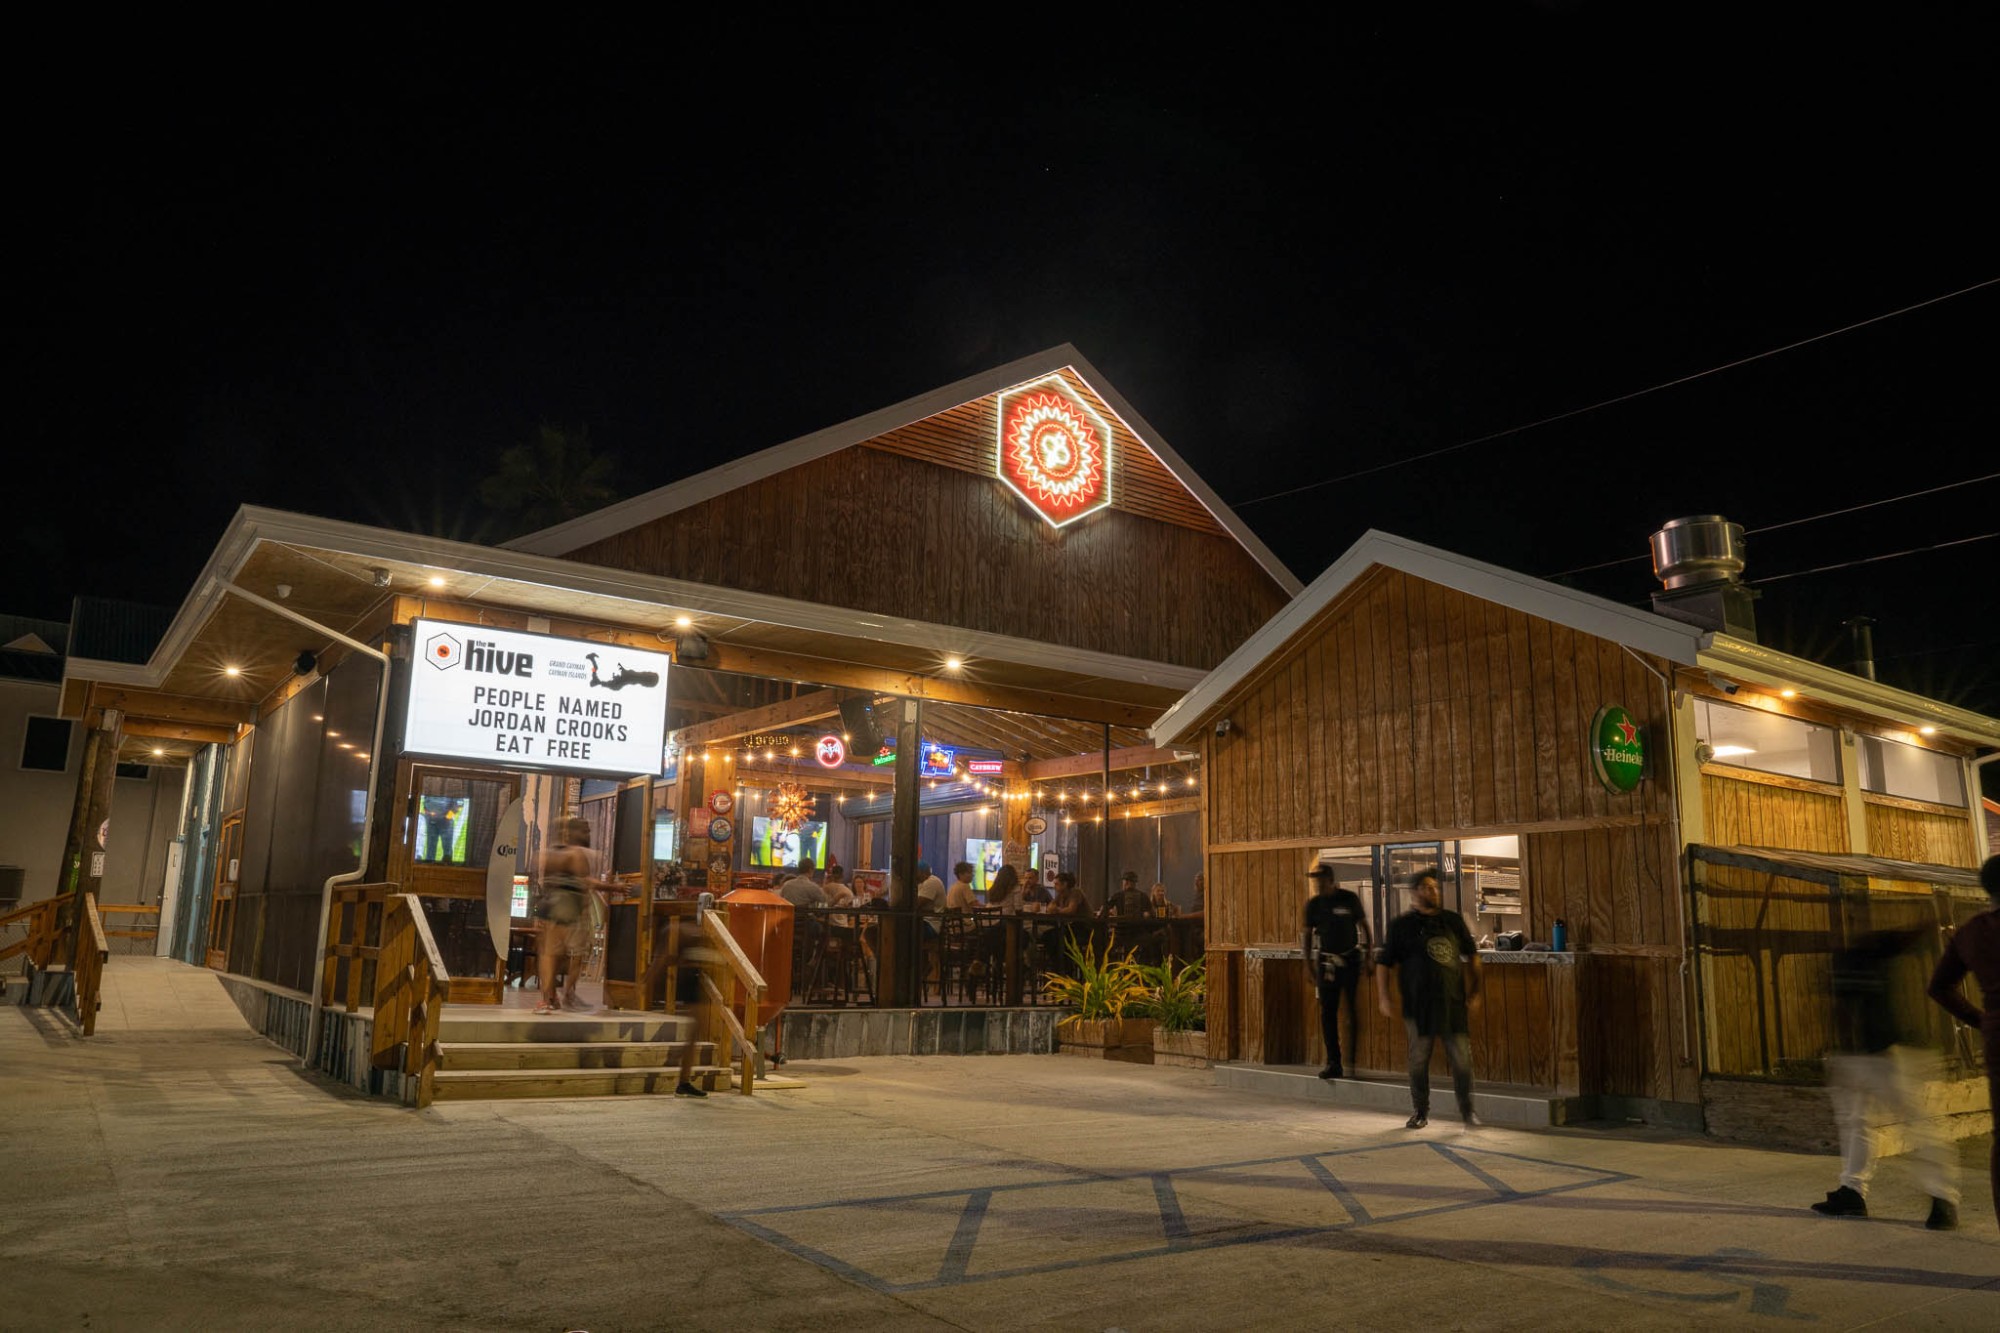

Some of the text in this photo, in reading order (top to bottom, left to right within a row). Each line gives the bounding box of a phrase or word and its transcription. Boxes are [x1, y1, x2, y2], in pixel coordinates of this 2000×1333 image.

[465, 639, 533, 678] hive
[549, 660, 586, 670] GRAND CAYMAN
[549, 669, 587, 680] CAYMAN ISLANDS
[473, 686, 622, 720] PEOPLE NAMED
[468, 708, 628, 742] JORDAN CROOKS
[496, 734, 591, 760] EAT FREE
